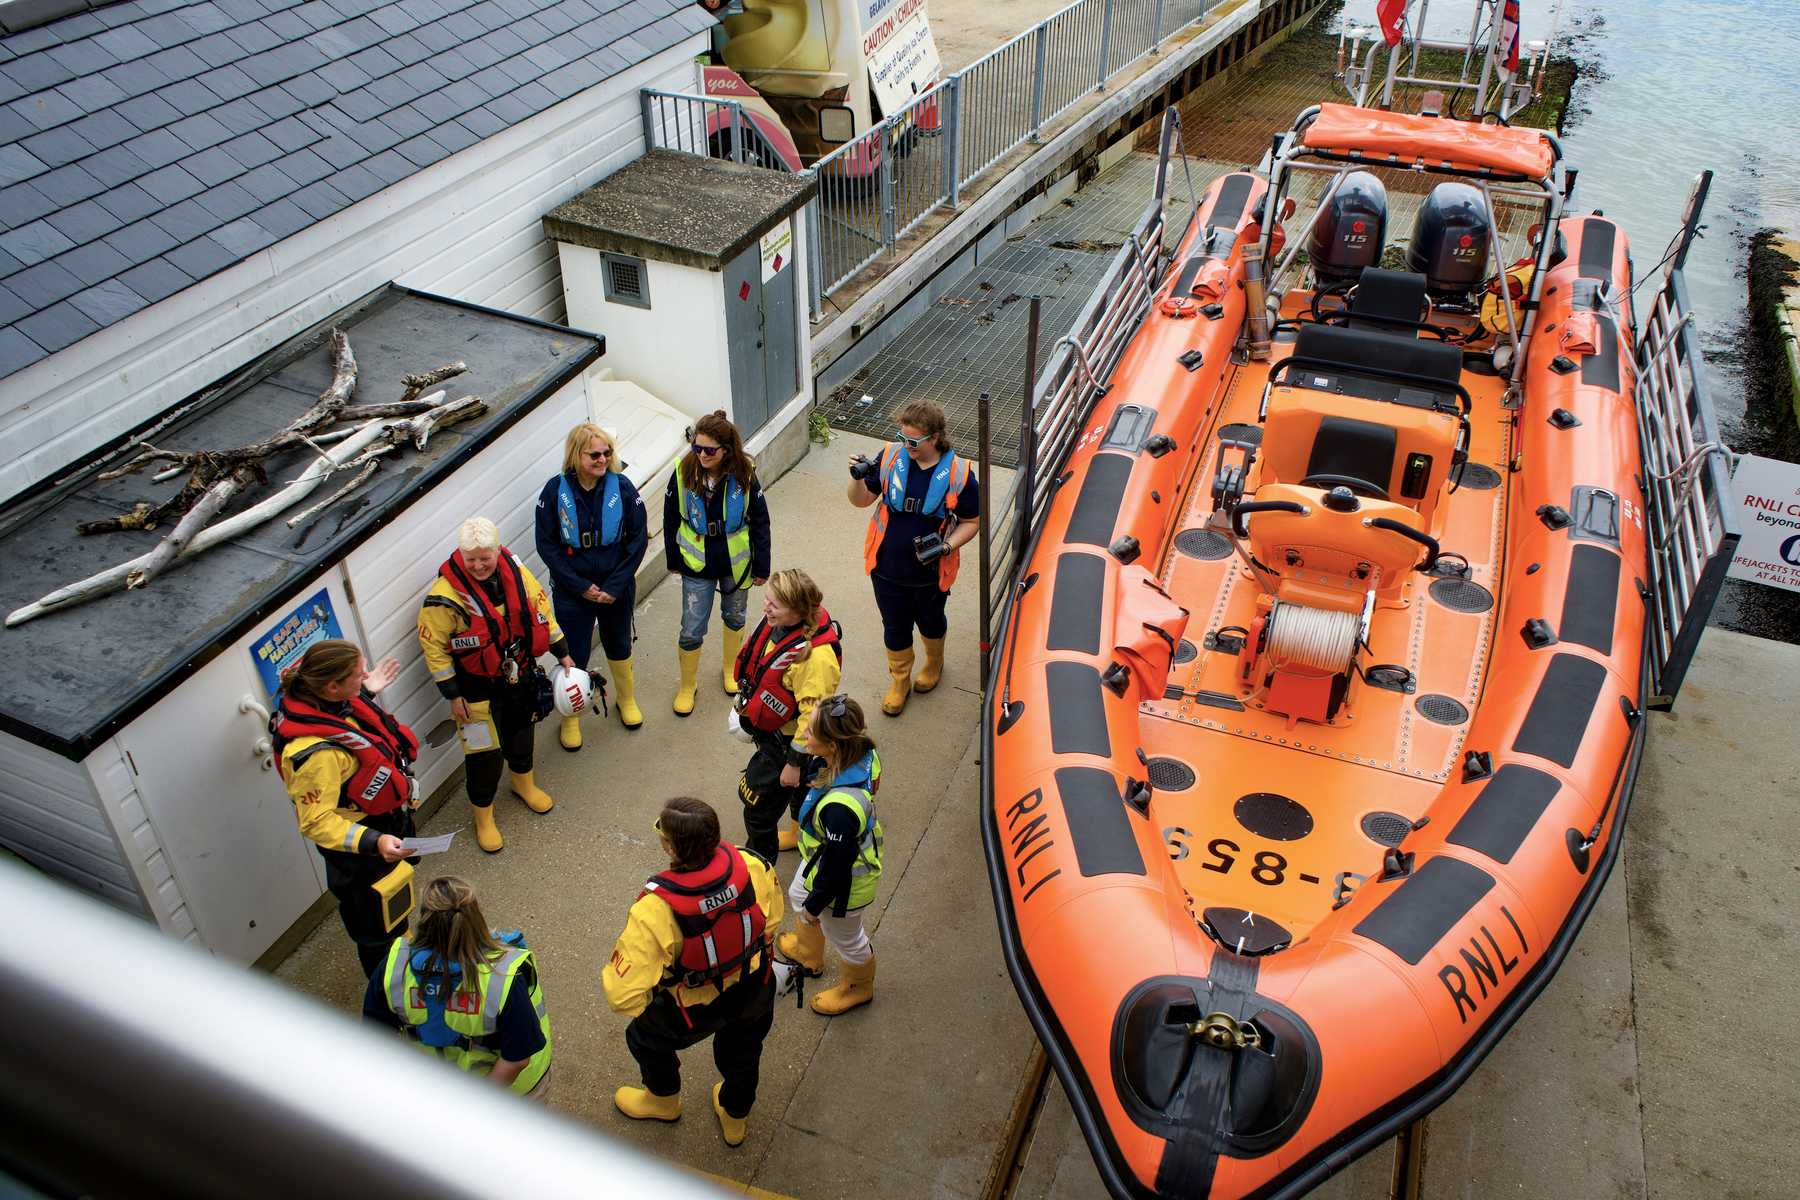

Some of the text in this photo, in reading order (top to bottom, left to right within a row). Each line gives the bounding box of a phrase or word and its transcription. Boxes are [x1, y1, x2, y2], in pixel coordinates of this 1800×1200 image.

[864, 16, 894, 57] CAUTION
[707, 79, 738, 93] you
[1344, 233, 1368, 243] 115
[1453, 248, 1477, 256] 115
[1743, 494, 1784, 512] RNLI
[1731, 555, 1789, 574] IFEJACKETS
[1755, 571, 1770, 579] AT
[1770, 574, 1786, 584] ALL
[454, 637, 476, 649] RNLI
[763, 693, 785, 714] RNLI
[365, 770, 389, 798] RNLI
[739, 776, 759, 806] RNLI
[1006, 787, 1062, 903] RNLI
[705, 887, 734, 911] RNLI
[1438, 906, 1529, 1025] RNLI
